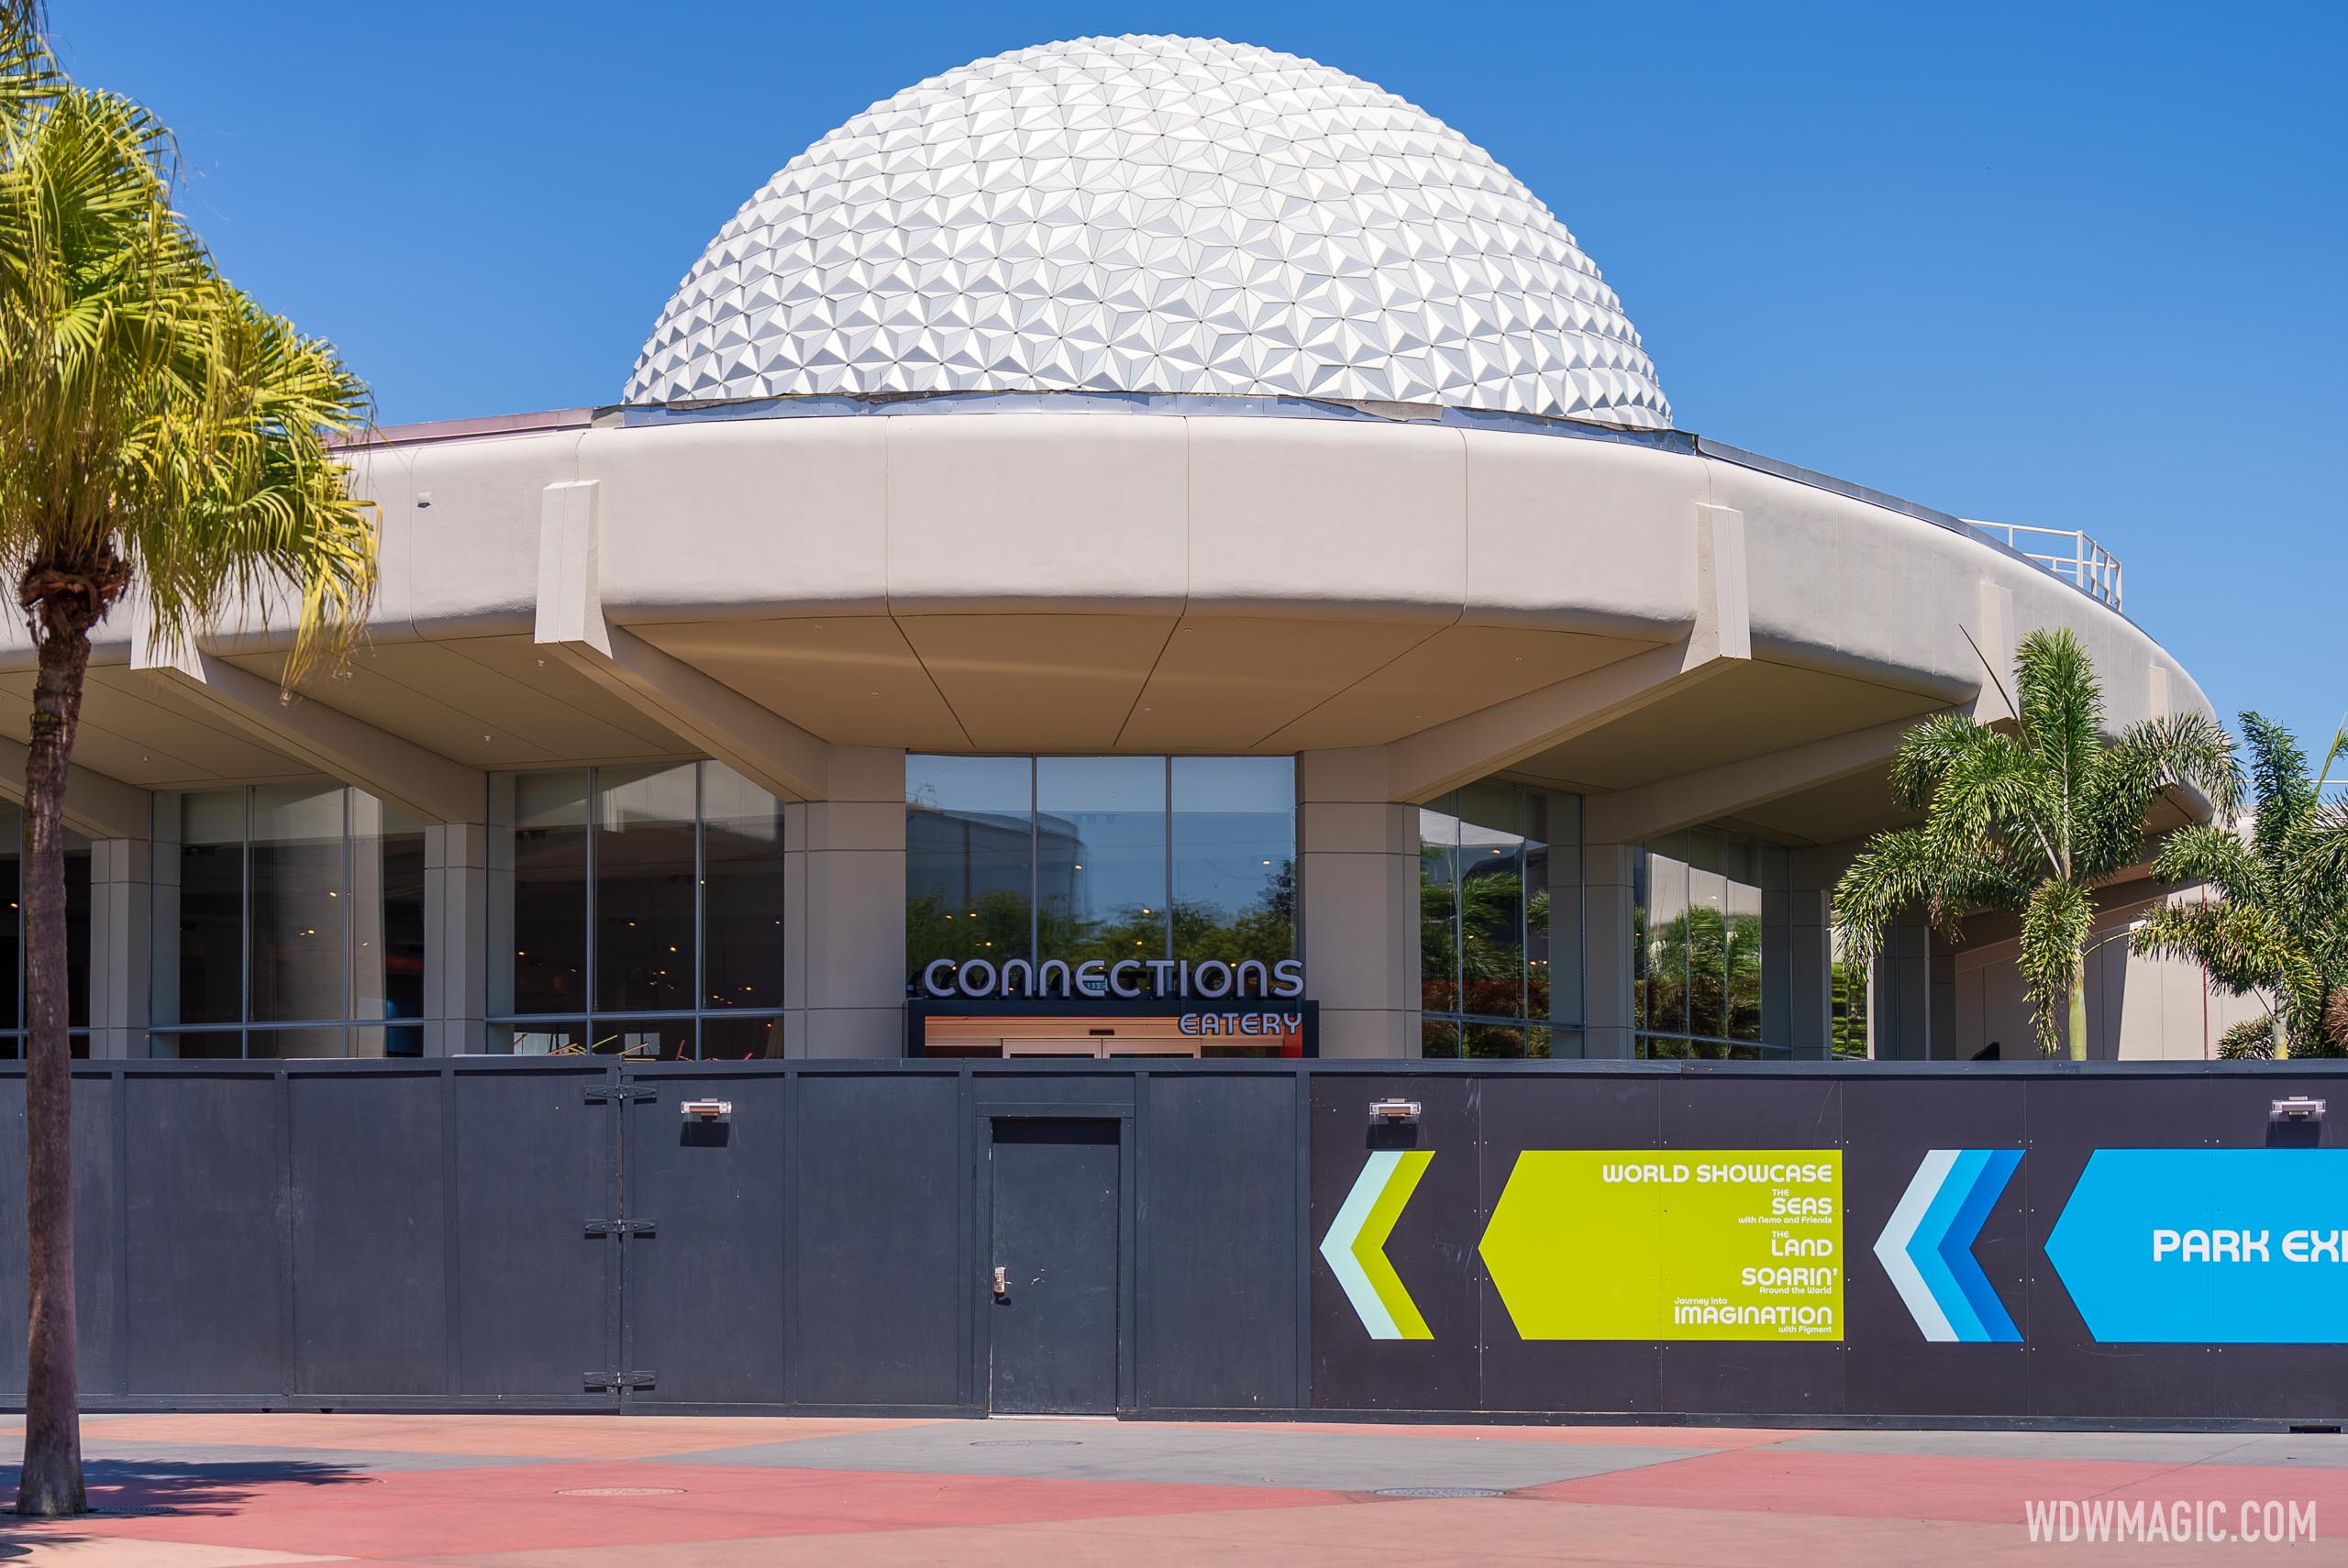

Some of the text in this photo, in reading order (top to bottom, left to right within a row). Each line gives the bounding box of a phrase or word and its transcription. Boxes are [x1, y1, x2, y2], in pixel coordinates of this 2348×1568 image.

[923, 958, 1305, 999] CONNECTIONS
[1178, 1012, 1302, 1036] EATERY
[1602, 1164, 1833, 1183] WORLD SHOWCASE
[1772, 1188, 1789, 1197] THE
[1771, 1197, 1833, 1215] SEAS
[1738, 1216, 1833, 1224] with Nemo and Friends
[1771, 1231, 1789, 1239] THE
[1771, 1239, 1833, 1257] LAND
[2154, 1230, 2270, 1263] PARK
[1759, 1286, 1833, 1295] Around the World
[1674, 1297, 1728, 1307] Journey into
[1674, 1306, 1833, 1325] IMAGINATION
[1778, 1325, 1833, 1335] with Figment
